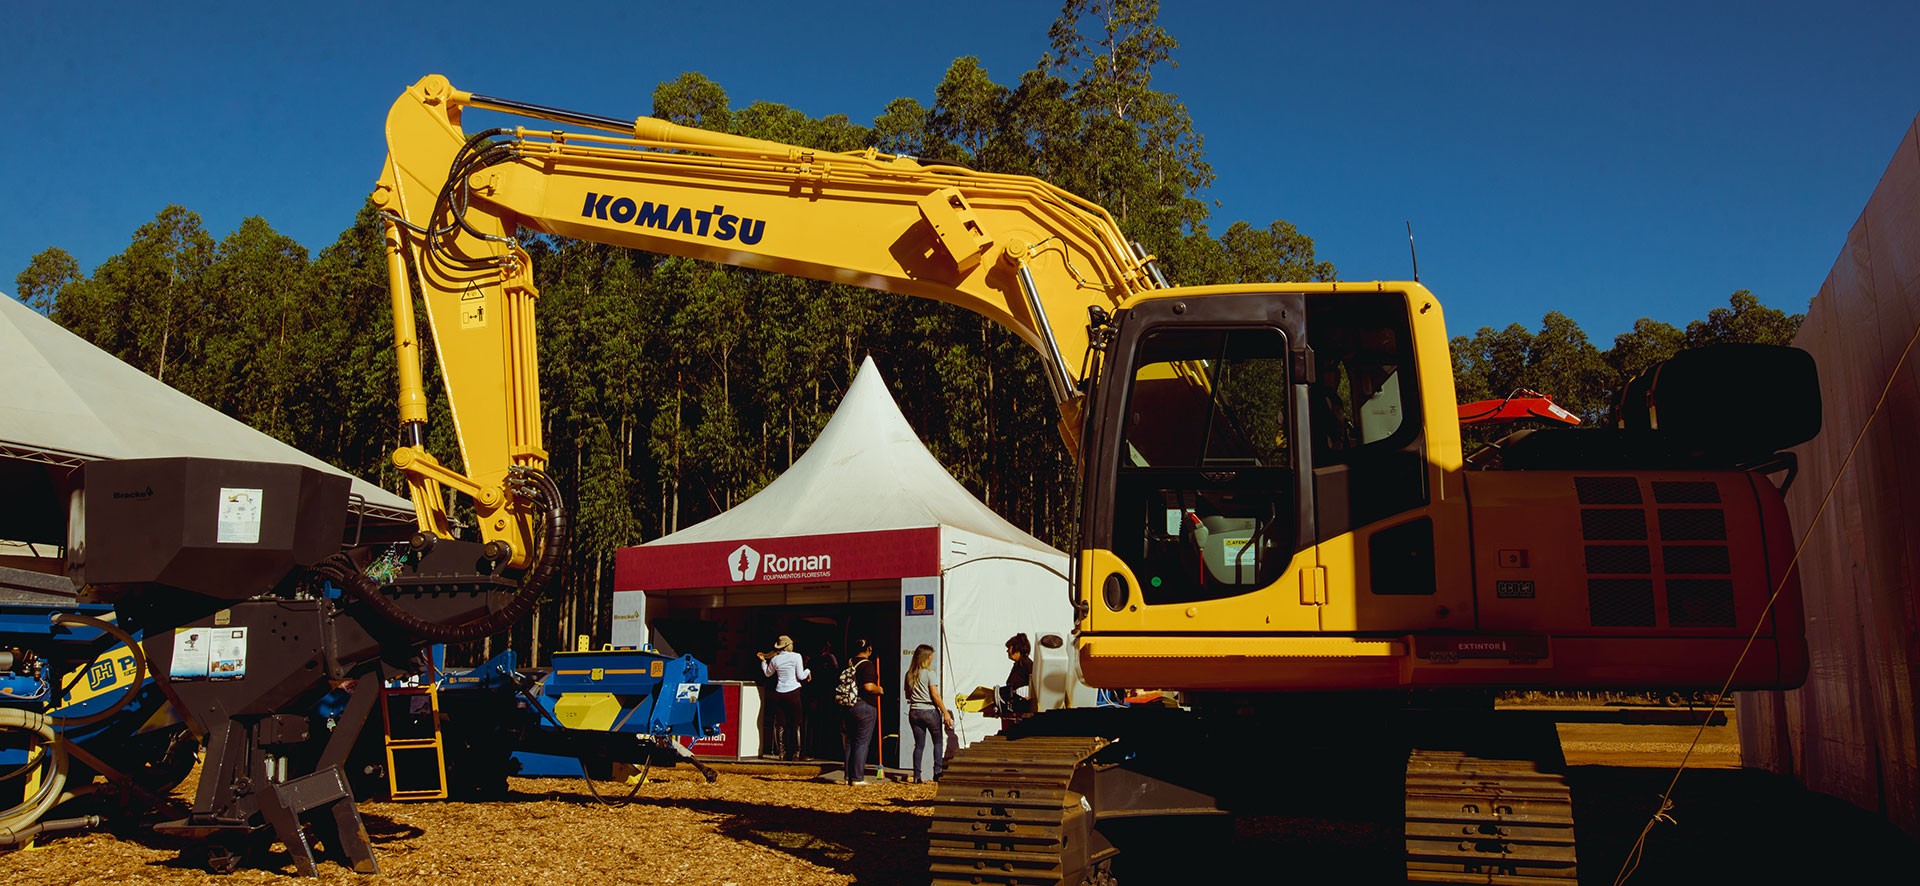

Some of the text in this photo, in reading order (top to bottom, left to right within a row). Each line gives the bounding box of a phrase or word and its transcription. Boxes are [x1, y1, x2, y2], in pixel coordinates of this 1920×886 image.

[581, 192, 766, 245] KOMATSU
[763, 553, 831, 573] Roman
[763, 573, 801, 581] EQUIPAMENTOS
